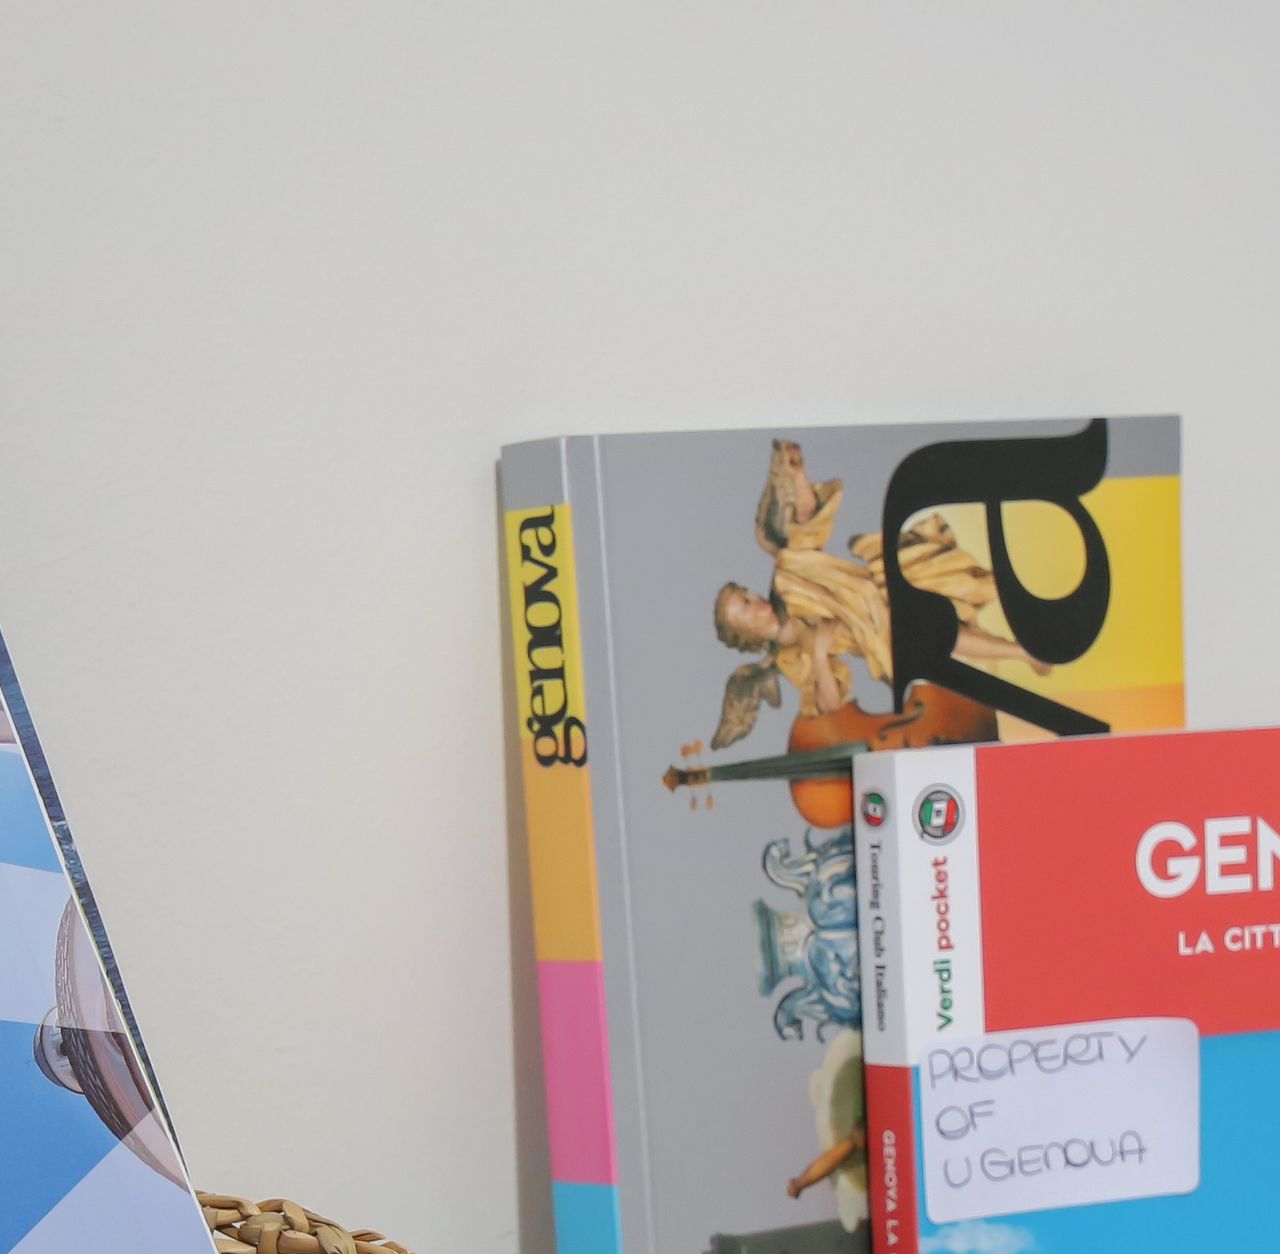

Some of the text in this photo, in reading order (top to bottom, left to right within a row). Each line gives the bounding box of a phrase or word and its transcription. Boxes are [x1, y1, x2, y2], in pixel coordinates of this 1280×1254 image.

[520, 504, 587, 767] genova
[869, 841, 887, 1032] Touring Club Italiano
[931, 856, 954, 1032] Verdi pocket
[1178, 931, 1215, 956] LA
[928, 1031, 1147, 1089] PROPERTY
[935, 1099, 995, 1140] OF
[882, 1129, 898, 1213] GENOVA
[886, 1219, 900, 1246] LA
